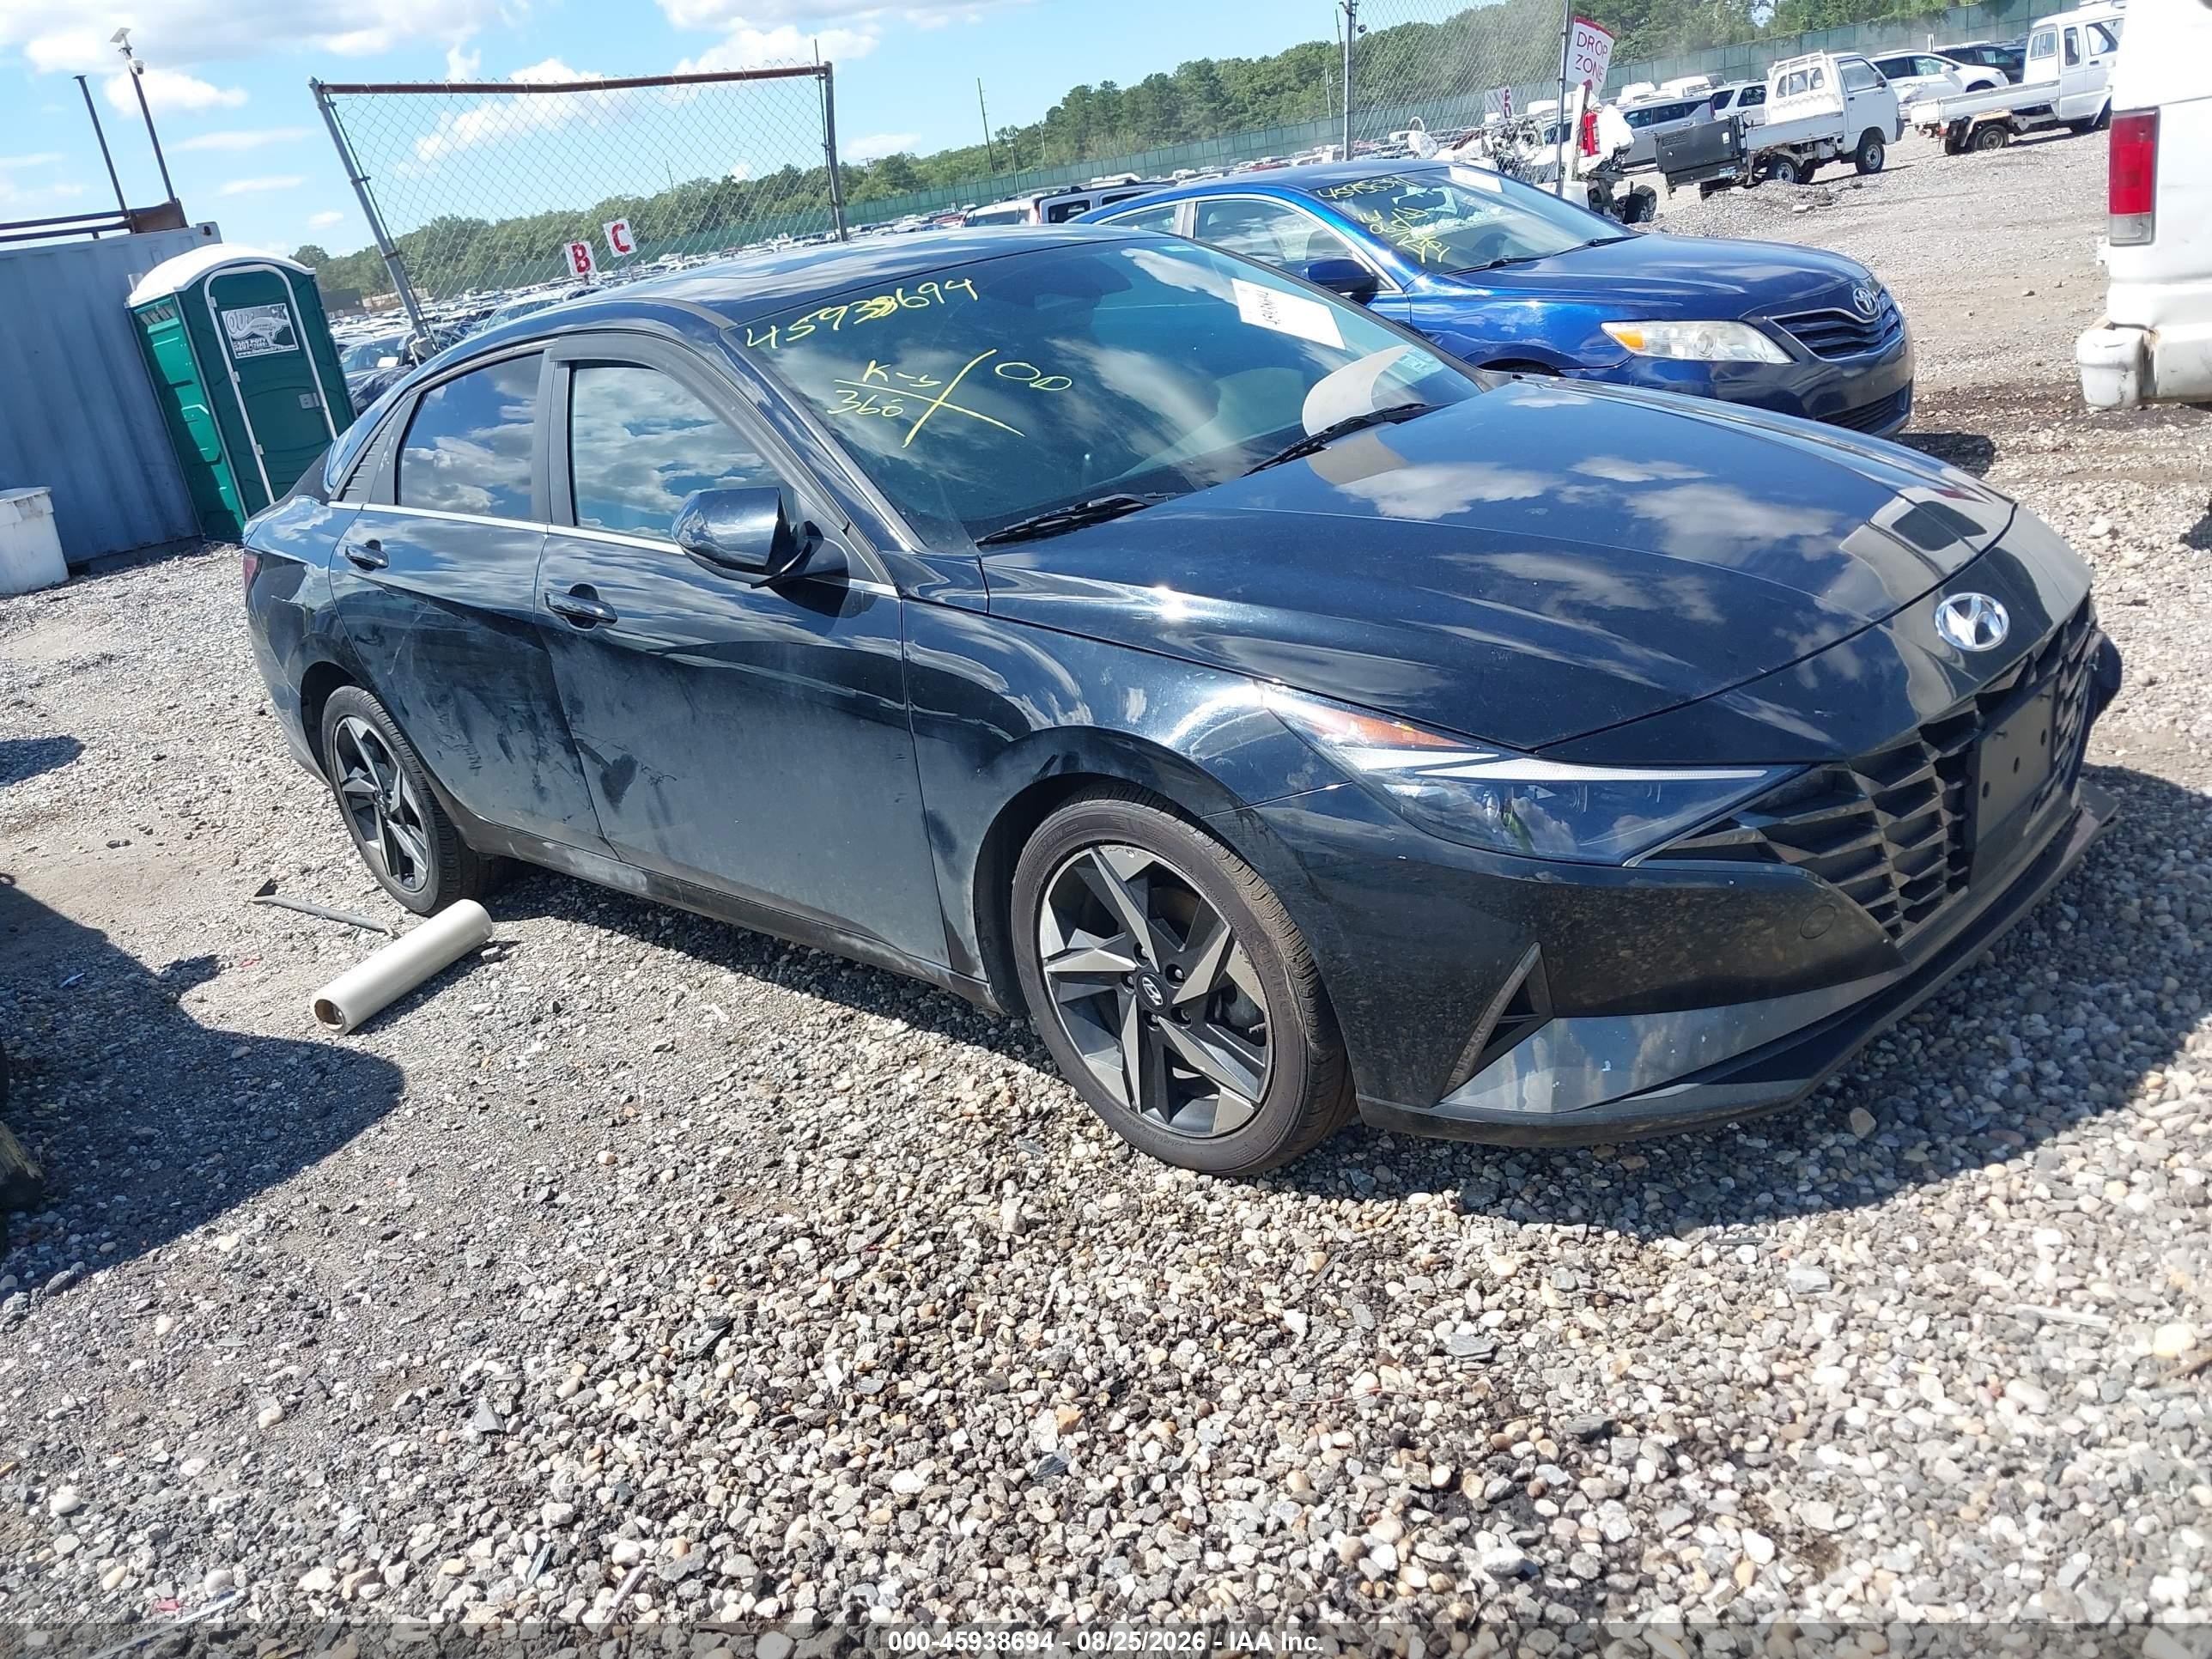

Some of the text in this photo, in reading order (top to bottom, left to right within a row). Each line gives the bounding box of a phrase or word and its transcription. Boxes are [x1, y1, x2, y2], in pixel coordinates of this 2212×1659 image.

[1577, 31, 1608, 59] DROP
[1575, 53, 1605, 83] ZONE
[611, 223, 631, 253] C
[571, 243, 592, 273] B
